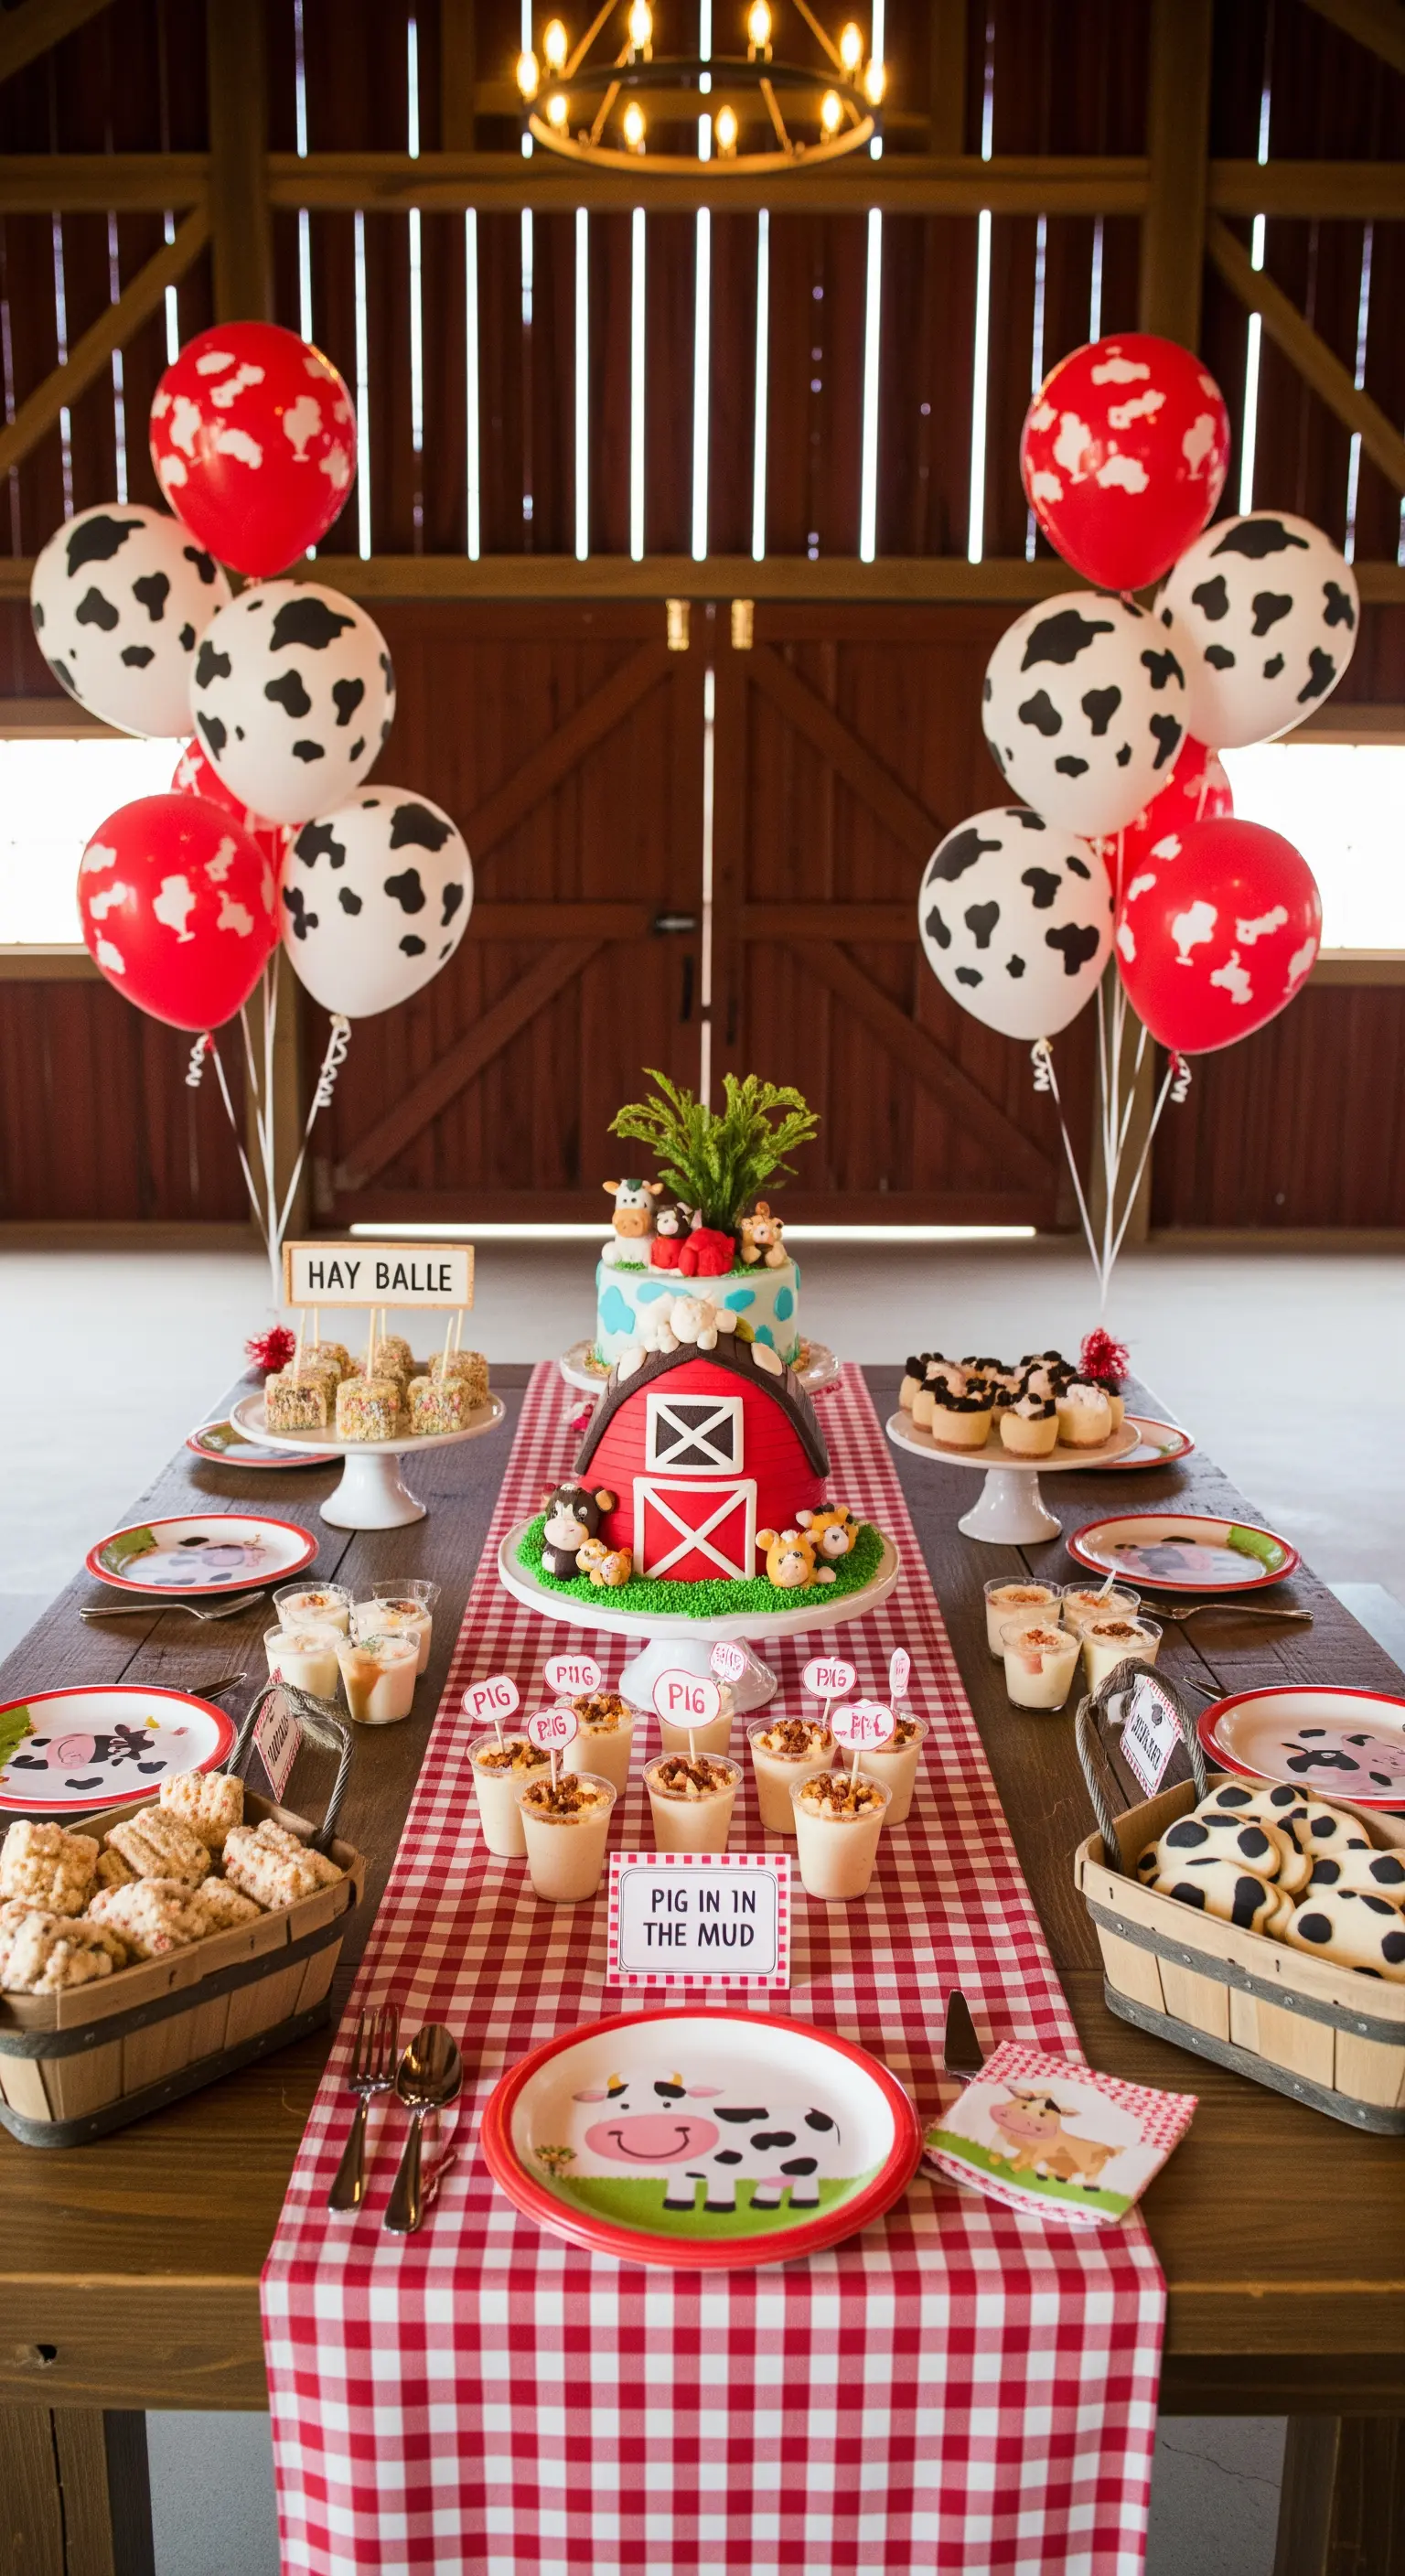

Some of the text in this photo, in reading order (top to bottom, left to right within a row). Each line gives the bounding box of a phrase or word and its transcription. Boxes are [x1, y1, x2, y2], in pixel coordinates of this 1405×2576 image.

[308, 1261, 452, 1292] HAY BALLE
[473, 1684, 510, 1716] PIG
[668, 1683, 705, 1714] PIG
[651, 1889, 756, 1914] PIG IN IN
[643, 1922, 755, 1948] THE MUD
